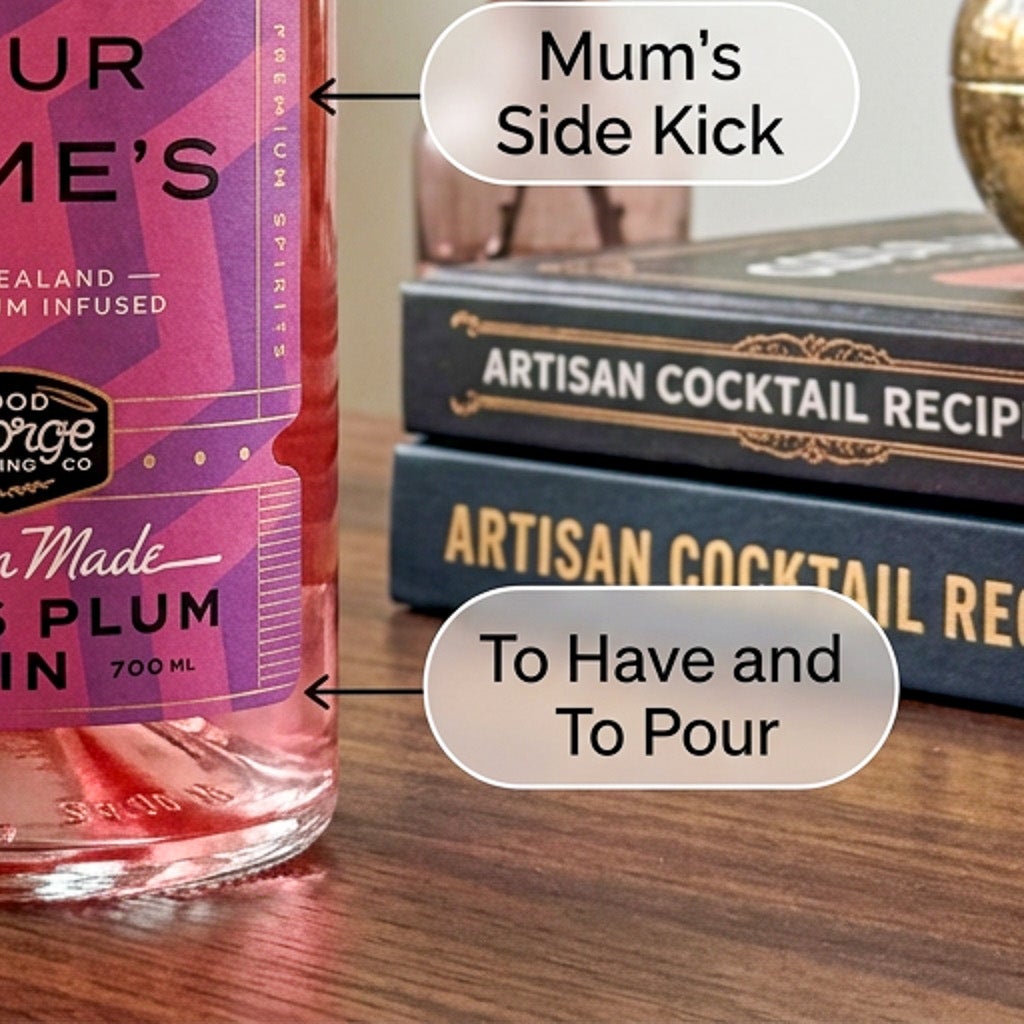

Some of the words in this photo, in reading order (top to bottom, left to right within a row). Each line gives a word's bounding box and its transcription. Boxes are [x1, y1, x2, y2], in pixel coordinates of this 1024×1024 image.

[43, 295, 167, 316] INFUSED
[482, 346, 645, 401] ARTISAN
[656, 364, 868, 425] COCKTAIL
[883, 385, 1024, 440] RECIP
[62, 457, 92, 471] CO
[21, 523, 223, 581] Made
[444, 503, 653, 586] ARTISAN
[669, 533, 924, 635] COCKTAIL
[944, 573, 1024, 648] RE
[40, 588, 219, 639] PLUM
[111, 658, 163, 678] 700
[170, 658, 196, 673] ML
